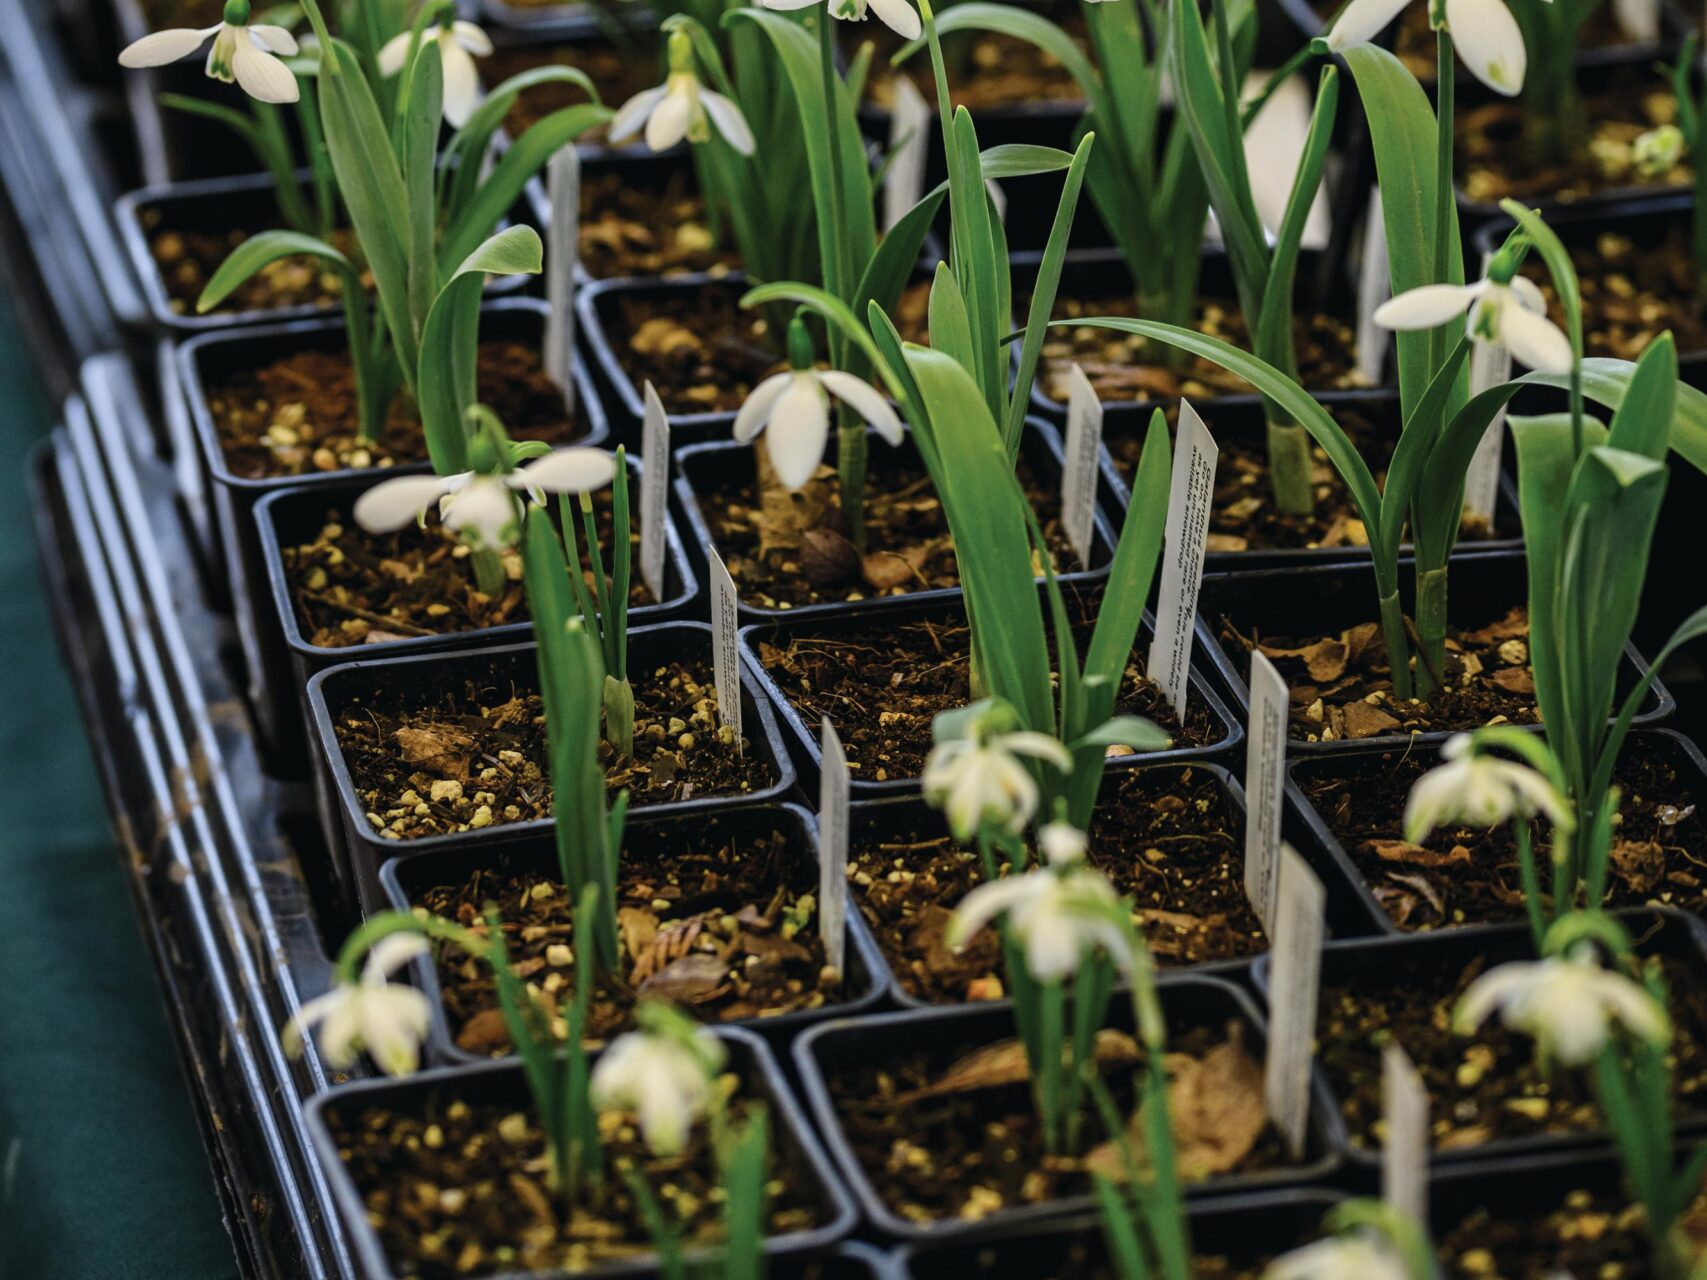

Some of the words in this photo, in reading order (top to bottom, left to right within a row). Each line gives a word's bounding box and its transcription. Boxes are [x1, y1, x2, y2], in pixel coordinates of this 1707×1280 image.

[1187, 445, 1197, 501] available
[1197, 452, 1202, 468] as
[1202, 461, 1207, 480] Go
[1197, 467, 1211, 547] Galanthus
[1178, 504, 1189, 568] snowdrop
[1180, 588, 1185, 602] or
[1186, 552, 1199, 619] seedling
[1169, 650, 1177, 690] widely
[1175, 674, 1180, 690] be
